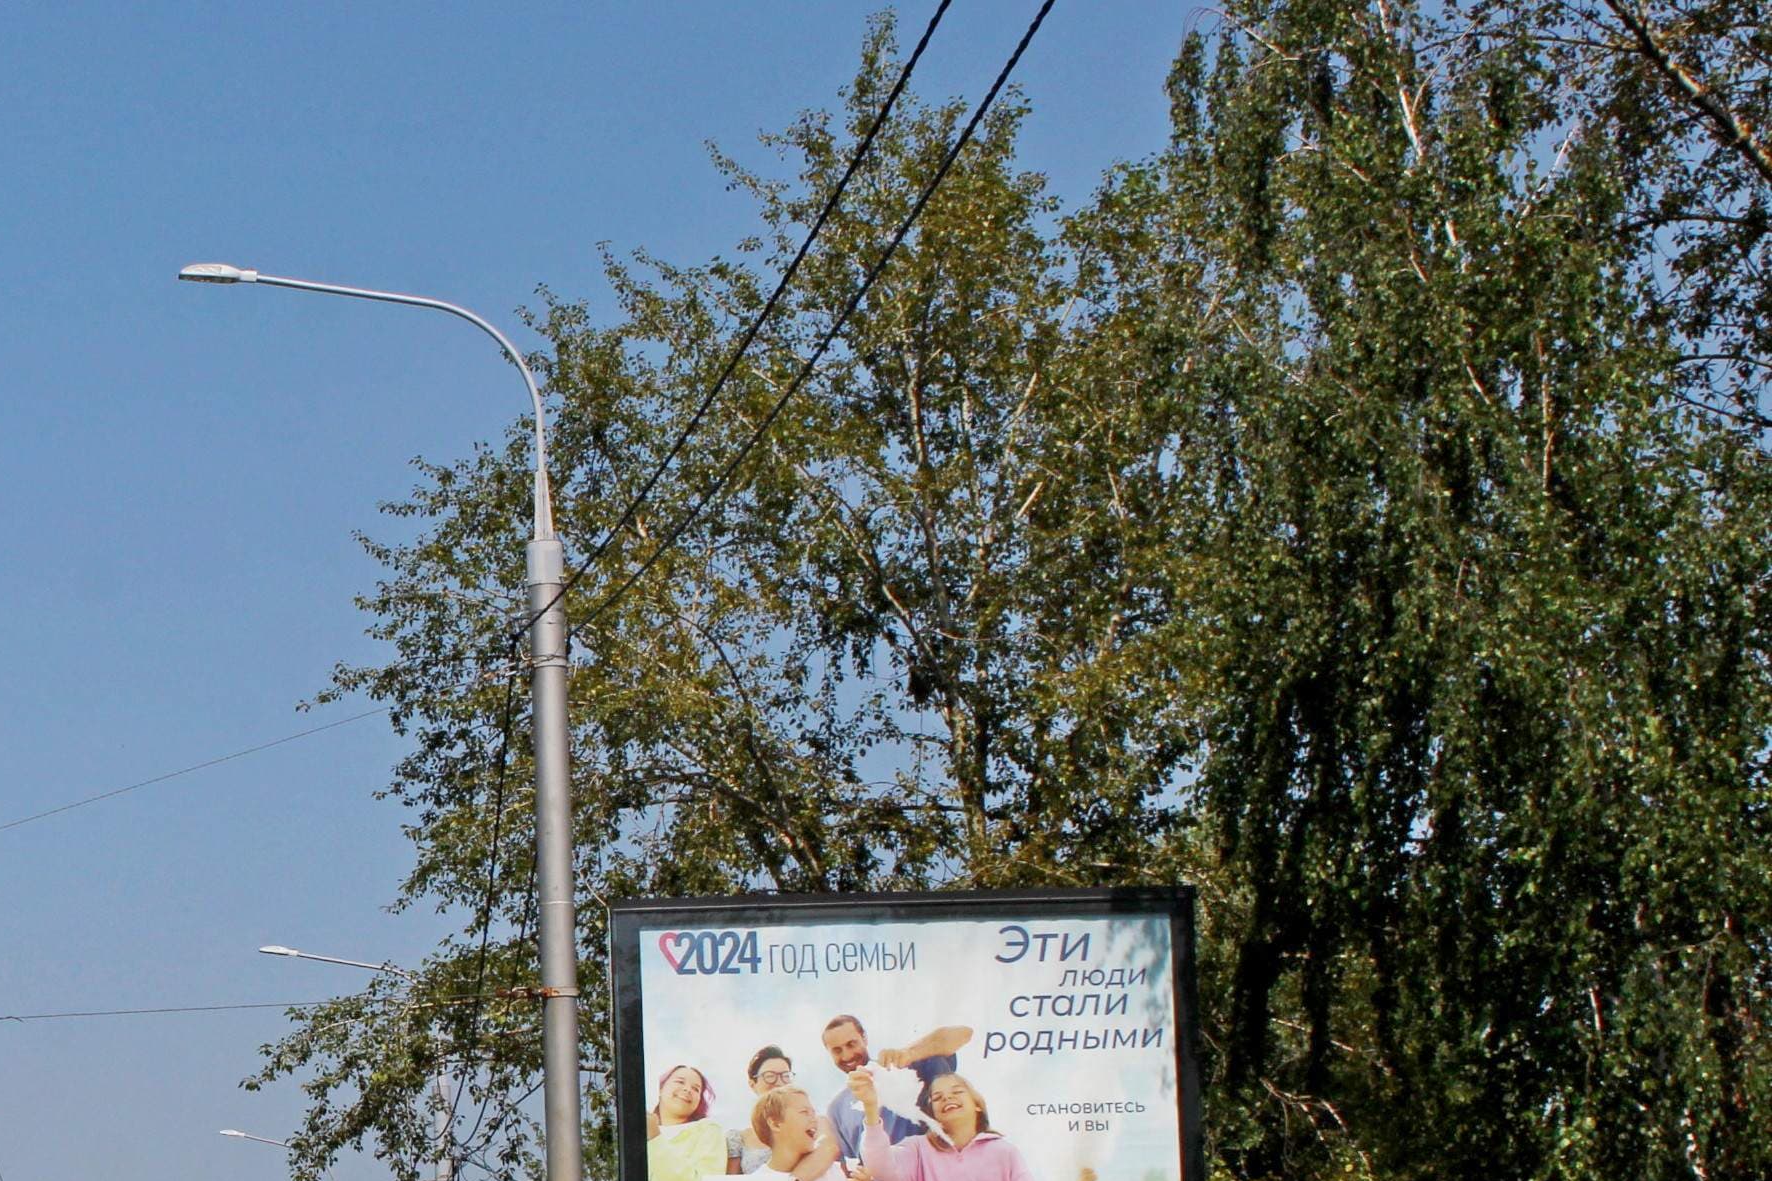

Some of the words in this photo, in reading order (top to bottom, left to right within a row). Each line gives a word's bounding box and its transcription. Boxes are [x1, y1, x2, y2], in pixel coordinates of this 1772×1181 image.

[676, 931, 762, 975] 2024
[769, 943, 819, 979] год
[825, 941, 916, 973] семьи
[994, 925, 1091, 963] Эти
[1058, 968, 1147, 989] люди
[1009, 993, 1129, 1017] стали
[983, 1028, 1164, 1059] родными
[1026, 1101, 1146, 1116] СТАНОВИТЕСЬ
[1068, 1120, 1080, 1132] И
[1085, 1120, 1109, 1131] ВЫ
